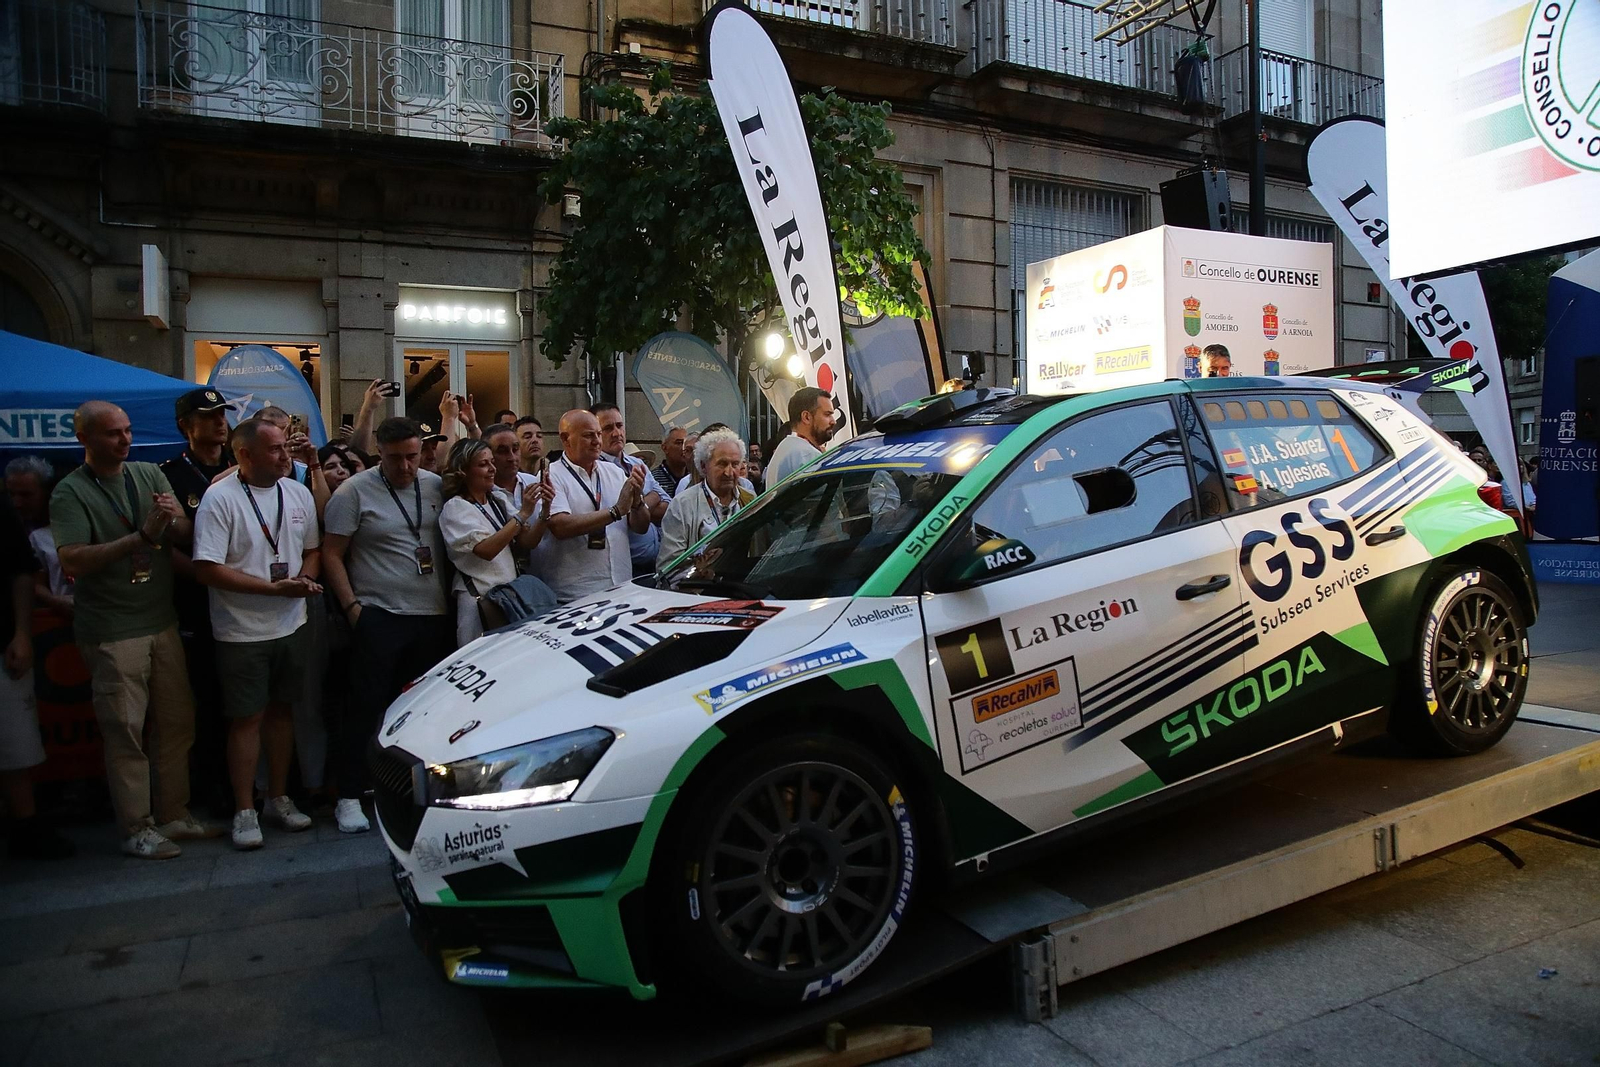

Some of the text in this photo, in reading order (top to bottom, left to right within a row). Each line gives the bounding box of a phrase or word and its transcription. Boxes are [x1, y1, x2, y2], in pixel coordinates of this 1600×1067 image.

[1532, 2, 1572, 139] CONSELLO
[735, 105, 781, 207] La
[1198, 263, 1320, 287] Concello de OURENSE
[403, 304, 507, 325] PARFOIS
[1204, 312, 1227, 321] Concello
[1205, 323, 1239, 332] AMOEIRO
[1282, 318, 1302, 326] Concello
[1049, 324, 1086, 338] MICHELIN
[1288, 329, 1313, 337] ARNOIA
[1401, 277, 1490, 397] egión
[1039, 361, 1086, 379] Rallycar
[1104, 351, 1140, 370] Recalvi
[1431, 363, 1469, 384] SKODA
[1250, 437, 1327, 465] J.A. Suárez
[1331, 428, 1360, 473] 1
[1259, 461, 1331, 490] A. Iglesias
[905, 495, 969, 560] SKODA
[983, 545, 1027, 571] RACC
[1239, 498, 1355, 602] GSS
[1260, 562, 1371, 635] Subsea Services
[1009, 597, 1139, 651] La Región
[960, 632, 989, 679] 1
[1422, 619, 1437, 688] MICHELIN
[747, 649, 858, 689] MICHELIN
[991, 679, 1045, 713] Recalvi
[1161, 645, 1326, 758] SKODA
[997, 709, 1035, 727] HOSPITAL
[999, 703, 1077, 743] recoletas salud
[1043, 719, 1079, 737] OURENSE
[444, 824, 502, 853] Asturias
[896, 820, 914, 916] MICHELIN
